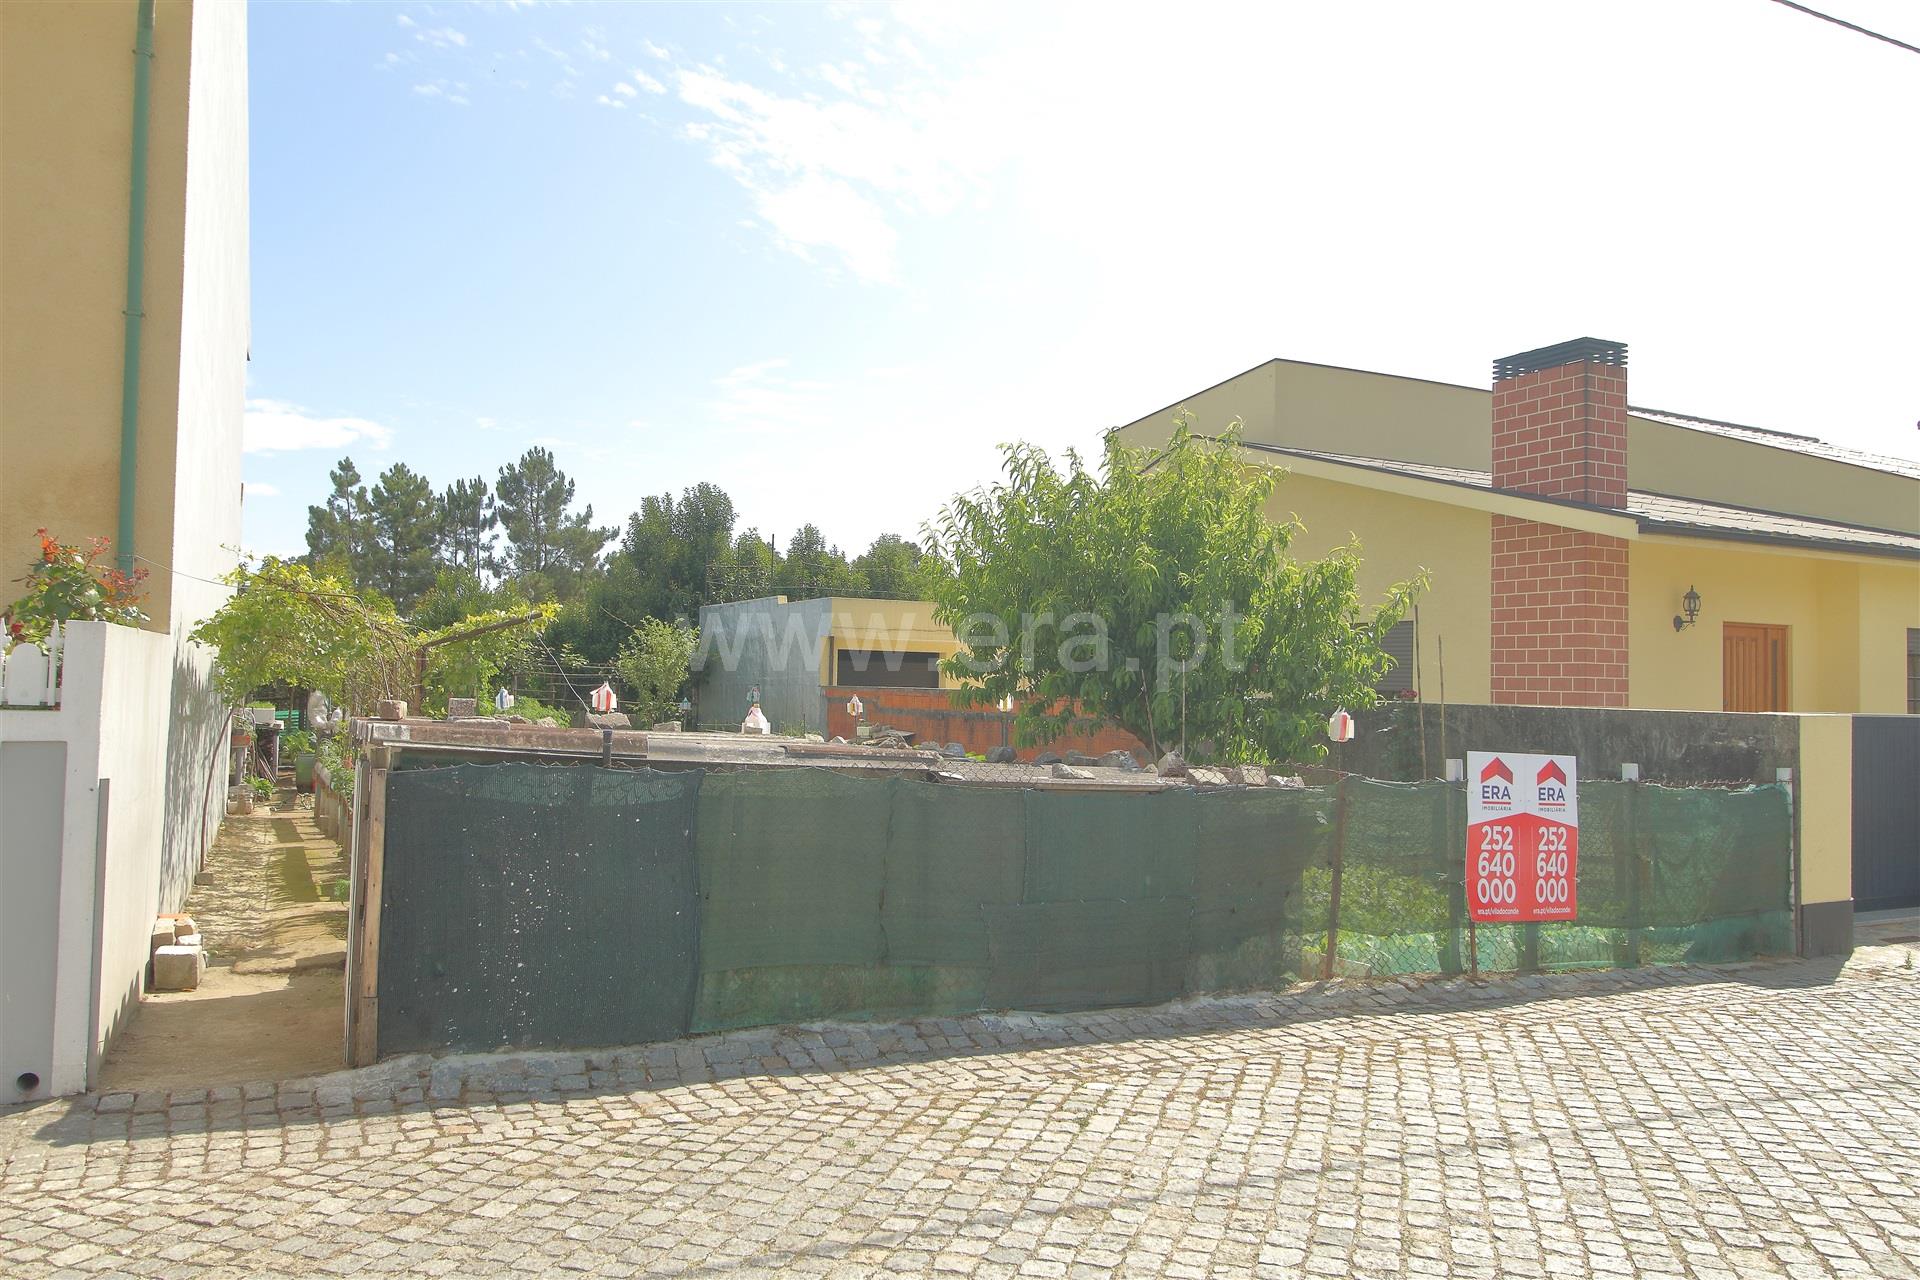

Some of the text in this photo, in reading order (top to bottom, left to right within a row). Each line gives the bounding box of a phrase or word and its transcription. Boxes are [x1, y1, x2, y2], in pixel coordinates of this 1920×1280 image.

[1482, 786, 1511, 800] ERA
[1538, 787, 1565, 801] ERA
[1481, 825, 1513, 851] 252
[1538, 826, 1567, 851] 252
[1477, 852, 1515, 877] 640
[1536, 852, 1568, 877] 640
[1477, 878, 1516, 904] 000
[1535, 878, 1568, 903] 000
